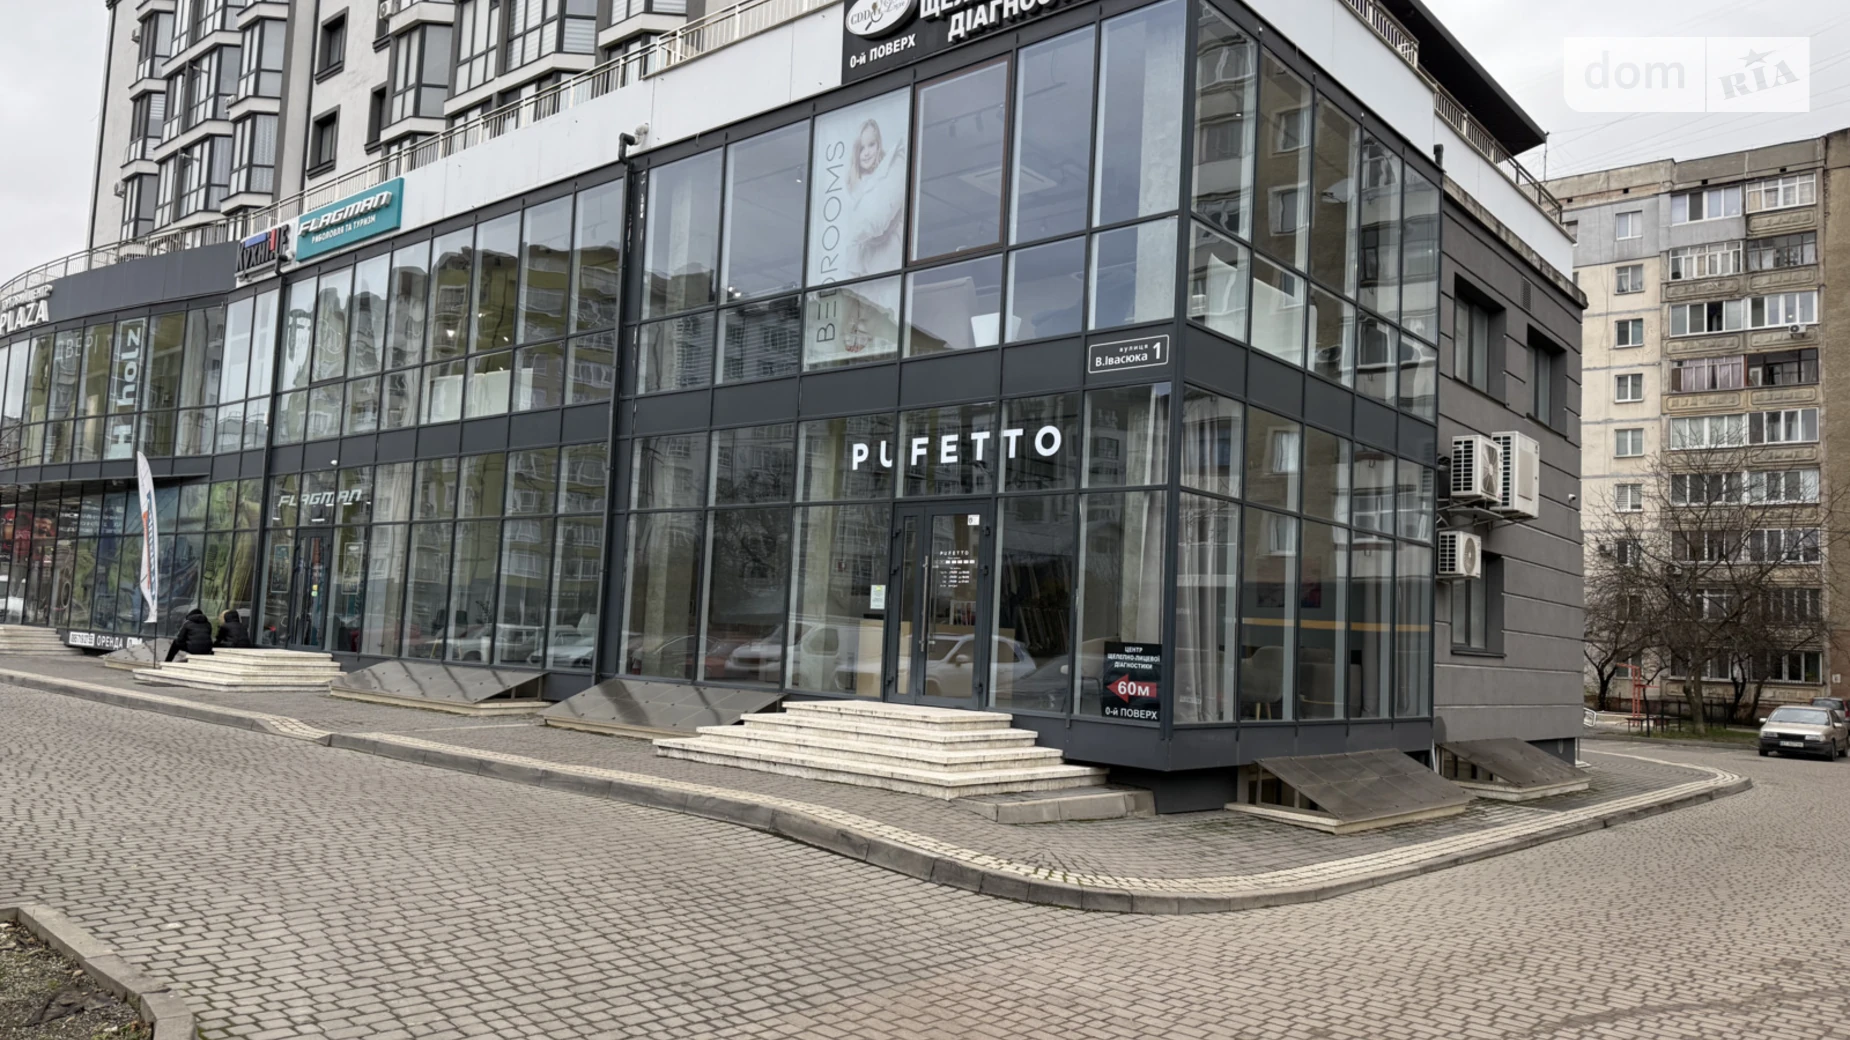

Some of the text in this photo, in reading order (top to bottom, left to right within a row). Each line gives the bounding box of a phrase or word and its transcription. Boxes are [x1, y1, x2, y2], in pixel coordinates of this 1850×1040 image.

[869, 33, 916, 61] ПОВЕРХ
[298, 191, 393, 237] FLAGMAN
[353, 213, 377, 230] ТУРИЗМ
[816, 140, 846, 343] BEDROOMS
[0, 299, 50, 335] PLAZA
[1095, 341, 1161, 368] В.Івасюка 1
[852, 425, 1062, 471] PUFETTO
[278, 488, 362, 508] FLAGMAN
[96, 634, 123, 651] ОРЕНДА
[1120, 708, 1157, 719] ПОВЕРХ
